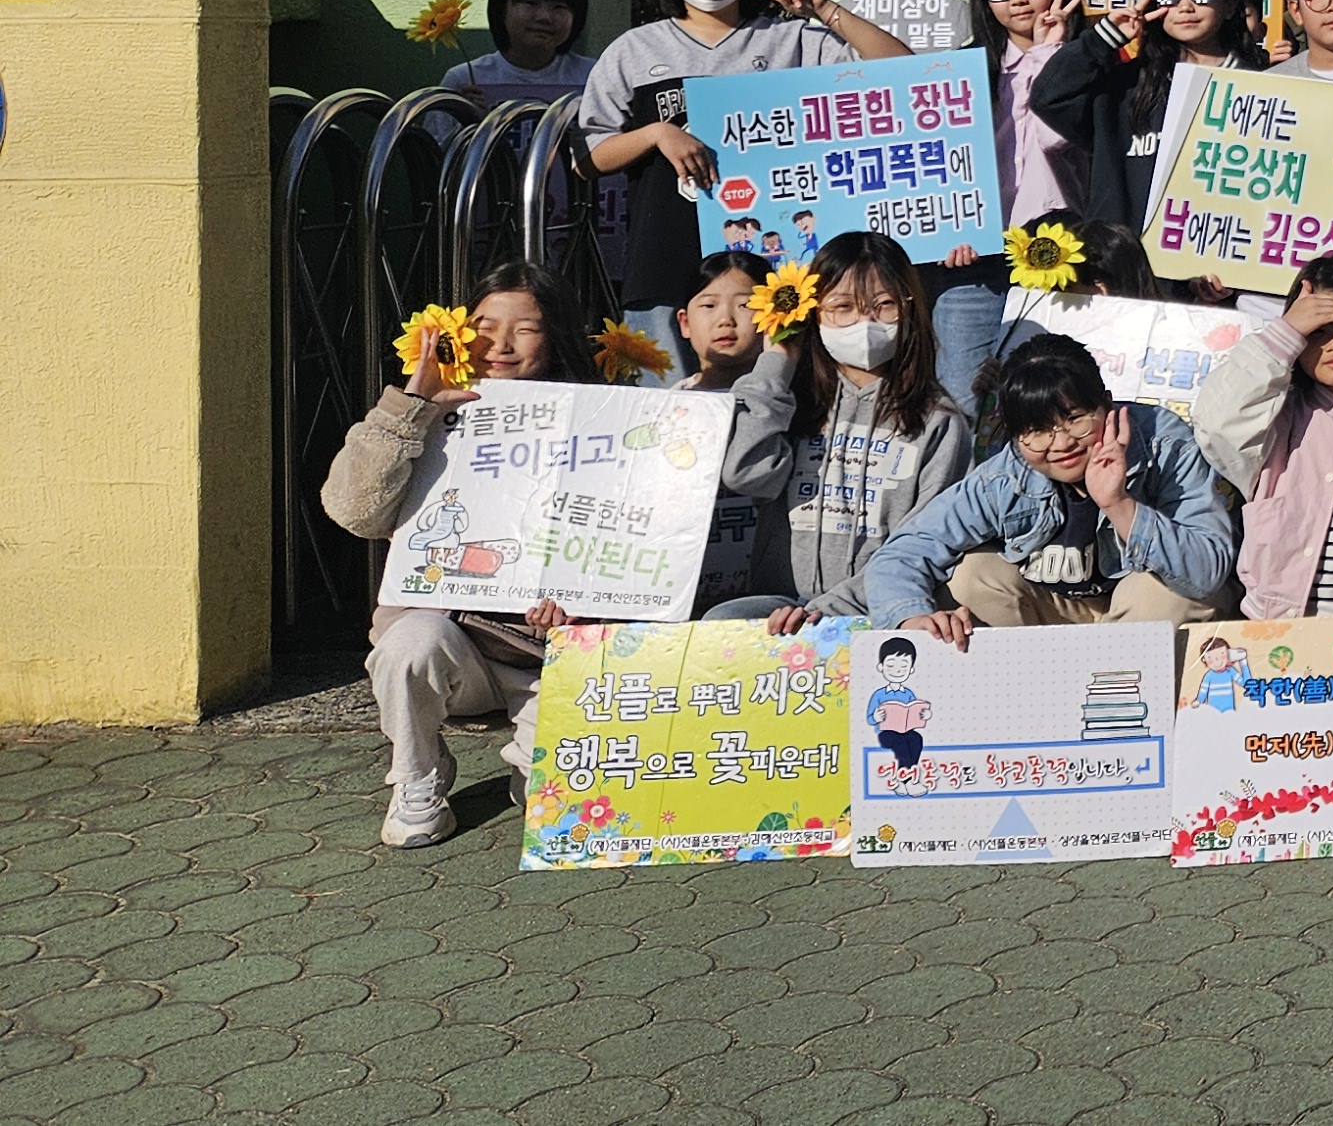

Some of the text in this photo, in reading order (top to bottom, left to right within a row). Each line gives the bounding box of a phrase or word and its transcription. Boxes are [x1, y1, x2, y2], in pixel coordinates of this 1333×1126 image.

[908, 23, 955, 49] 말들
[721, 78, 974, 154] 사소한 괴롭힘, 장난
[1201, 80, 1299, 144] 나에게는
[1126, 132, 1162, 157] NO
[723, 189, 753, 201] STOP
[770, 139, 975, 203] 또한 학교폭력에
[1192, 139, 1307, 207] 작은상처
[865, 189, 985, 239] 해당됩니다
[1160, 196, 1252, 261] 남에게는
[469, 433, 627, 478] 독이되고,
[441, 582, 499, 597] (재)선플재단
[592, 591, 672, 606] 김해신안초등학교
[576, 664, 834, 722] 선플로 뿌린 씨앗
[555, 733, 697, 792] 행복으로
[898, 839, 957, 853] (재)선플재단
[1237, 832, 1297, 847] (재)선플재단
